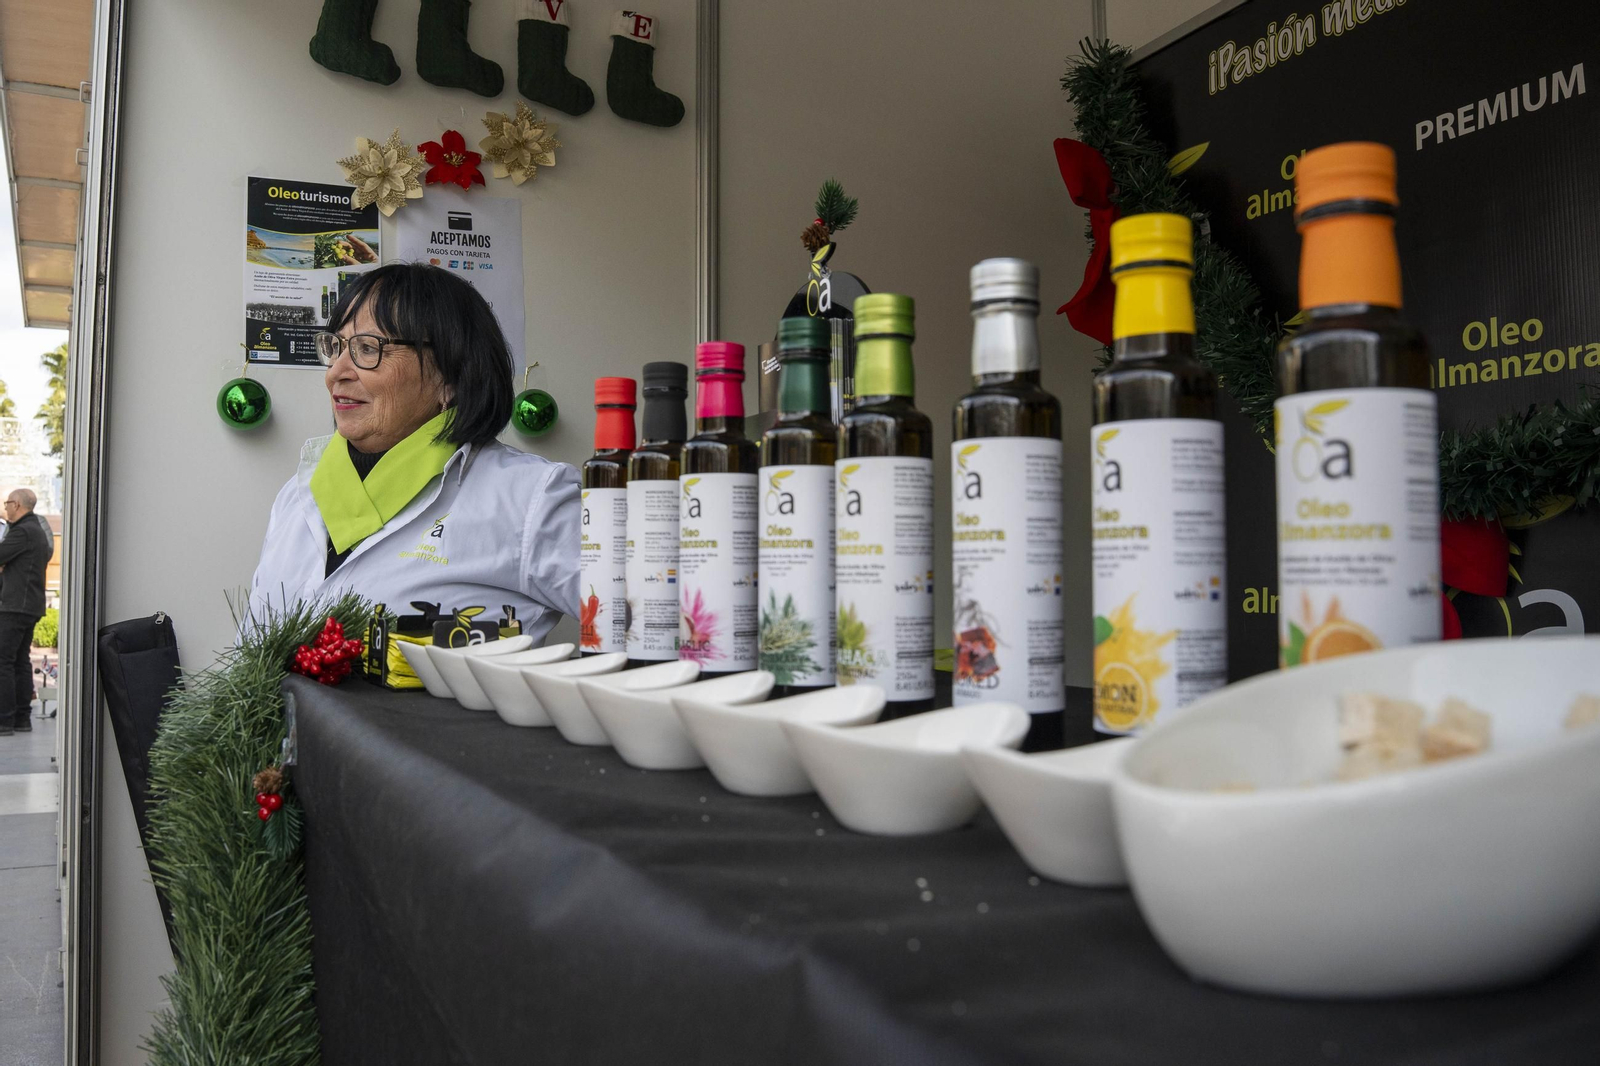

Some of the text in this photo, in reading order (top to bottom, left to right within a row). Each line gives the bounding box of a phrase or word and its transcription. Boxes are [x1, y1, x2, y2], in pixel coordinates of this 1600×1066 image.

[630, 14, 653, 39] E
[1416, 62, 1586, 151] PREMIUM
[268, 186, 350, 204] Oleoturismo
[430, 231, 490, 248] ACEPTAMOS
[1462, 316, 1543, 351] Oleo
[1430, 342, 1600, 389] lmanzora
[1297, 497, 1351, 519] Oleo
